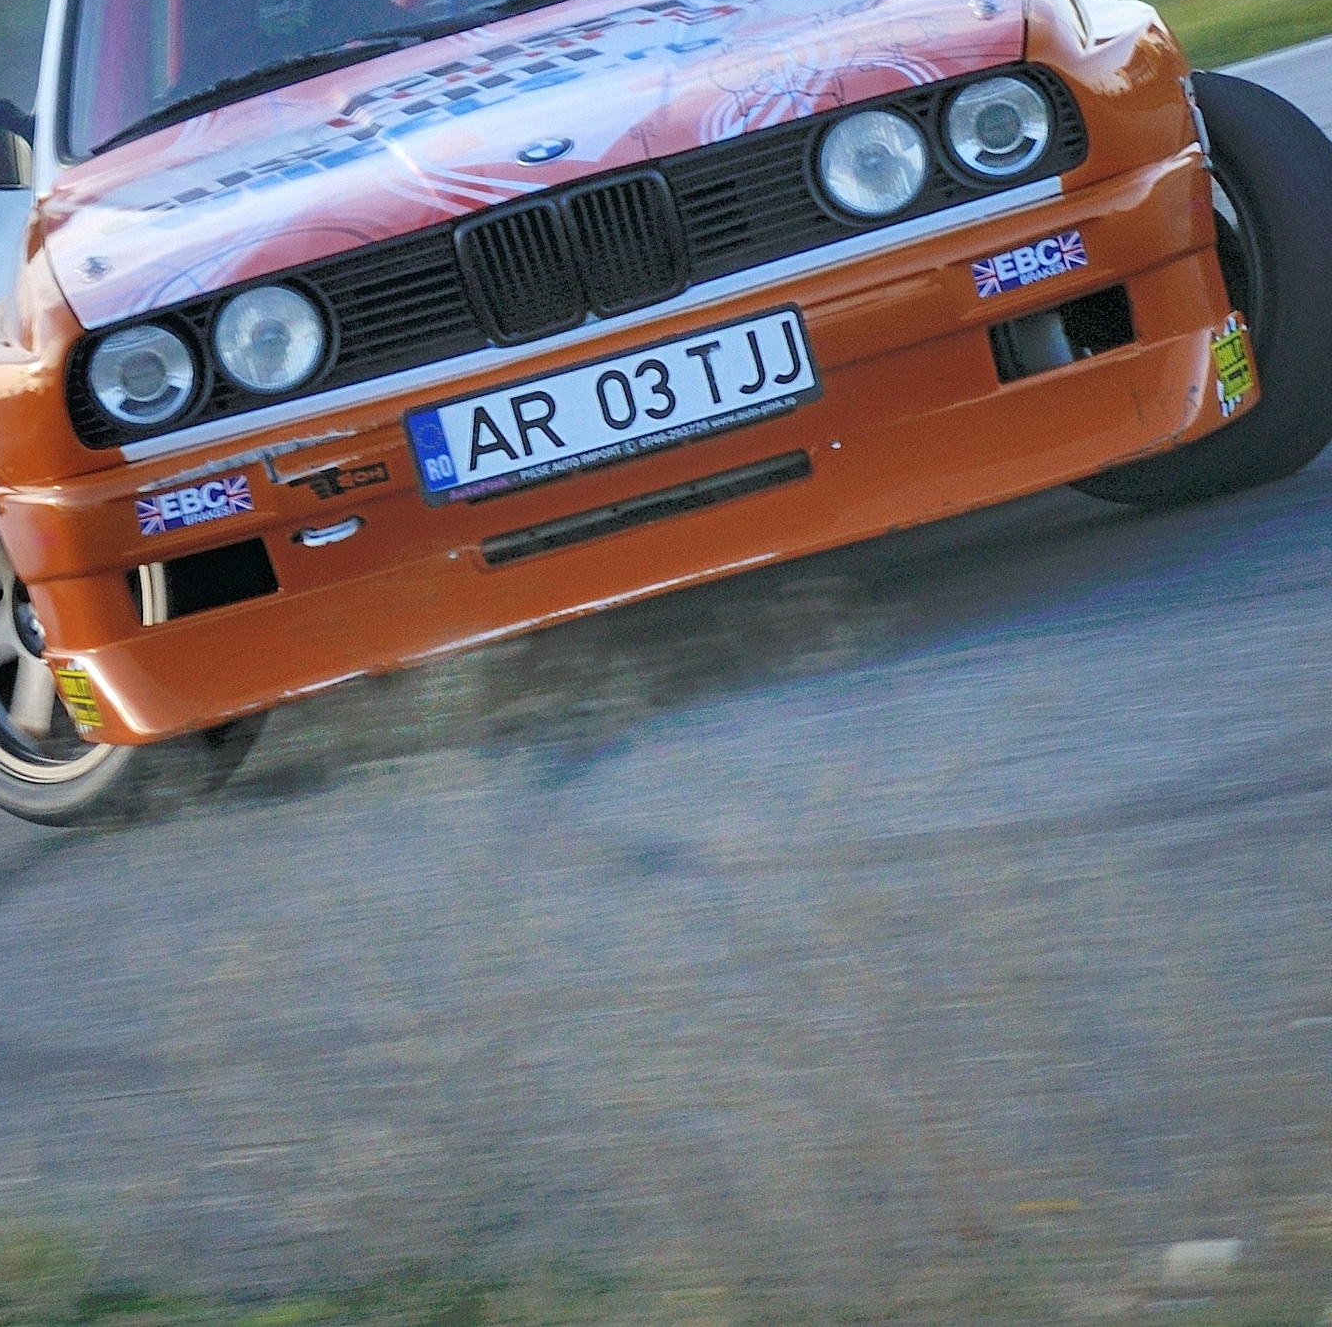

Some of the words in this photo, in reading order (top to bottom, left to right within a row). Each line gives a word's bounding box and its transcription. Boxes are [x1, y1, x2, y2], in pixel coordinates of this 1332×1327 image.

[995, 240, 1063, 281] EBC
[469, 391, 565, 471] AR
[596, 359, 676, 430] 03
[686, 321, 801, 404] TJJ
[426, 454, 454, 481] RO
[161, 482, 228, 520] EBC
